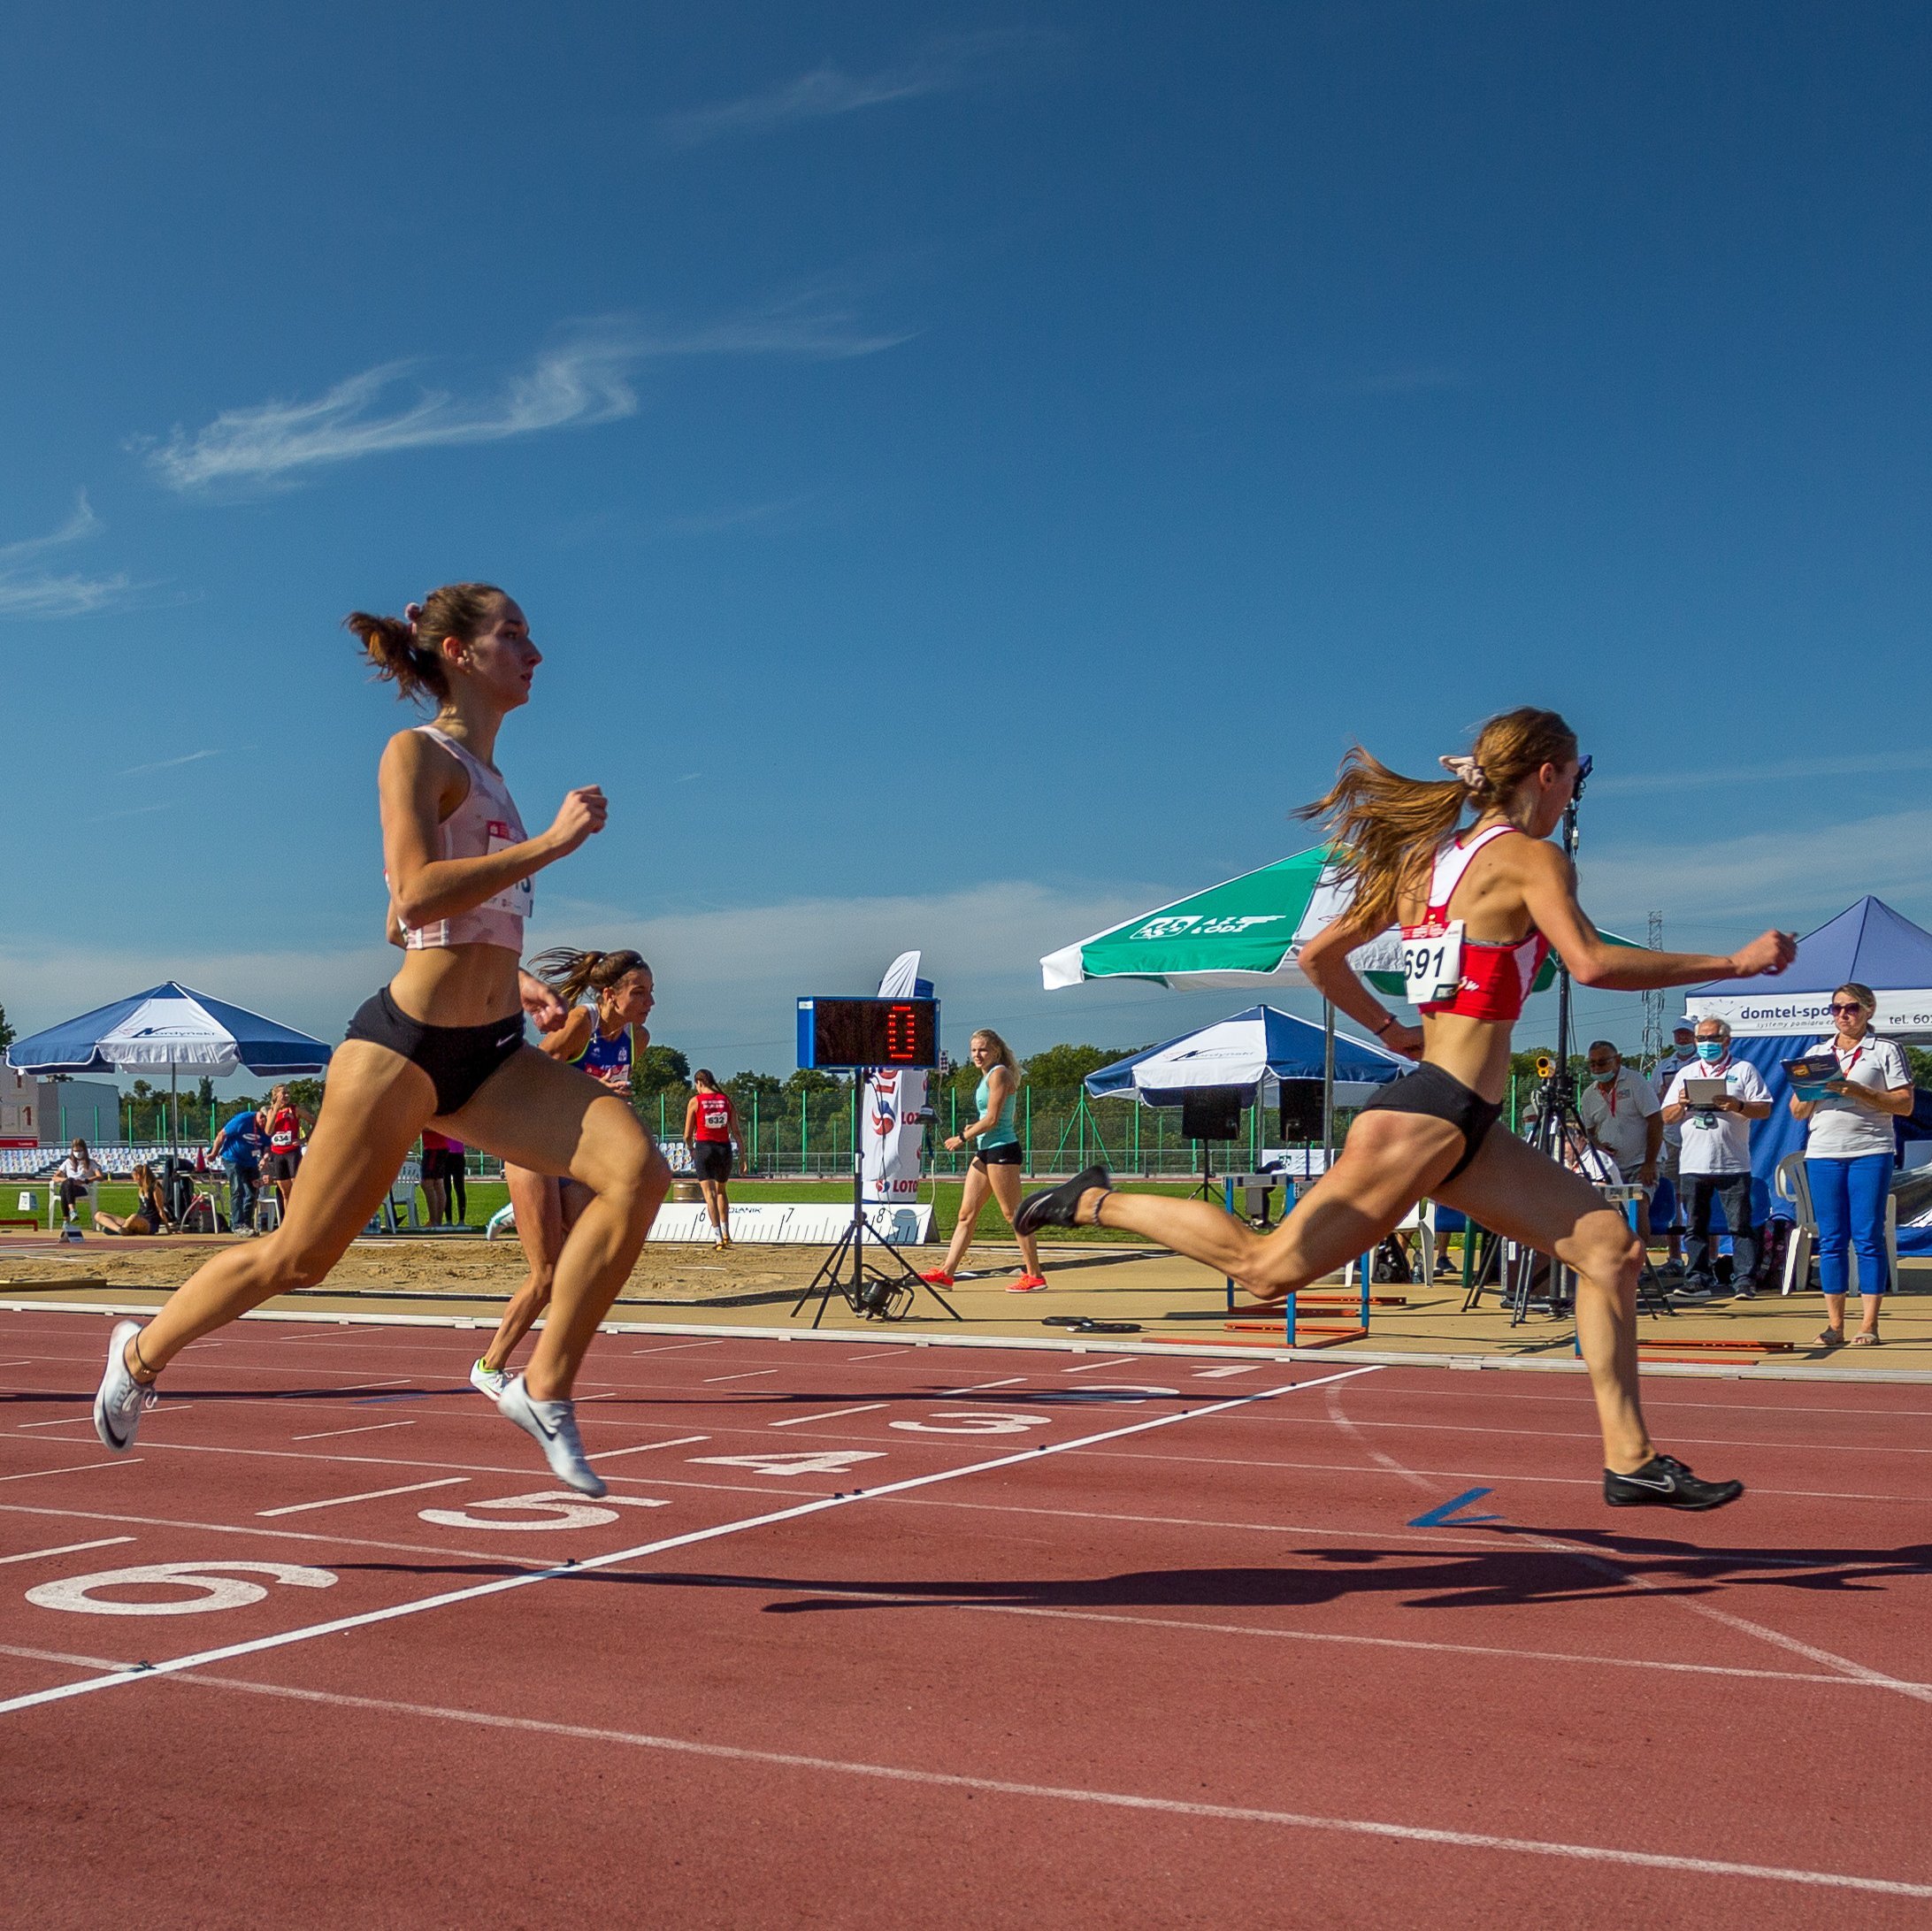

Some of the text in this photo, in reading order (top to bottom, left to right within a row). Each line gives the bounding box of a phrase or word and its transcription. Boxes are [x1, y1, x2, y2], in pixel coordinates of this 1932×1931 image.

[1404, 946, 1445, 981] 691
[1889, 1014, 1932, 1024] tel. 60
[887, 1006, 916, 1059] 0
[273, 1134, 289, 1143] 634
[699, 1207, 706, 1222] 6
[786, 1207, 795, 1222] 7
[876, 1207, 886, 1223] 8
[888, 1413, 1053, 1435] 3
[683, 1451, 889, 1475] 4
[417, 1490, 673, 1530] 5
[24, 1561, 339, 1615] 6
